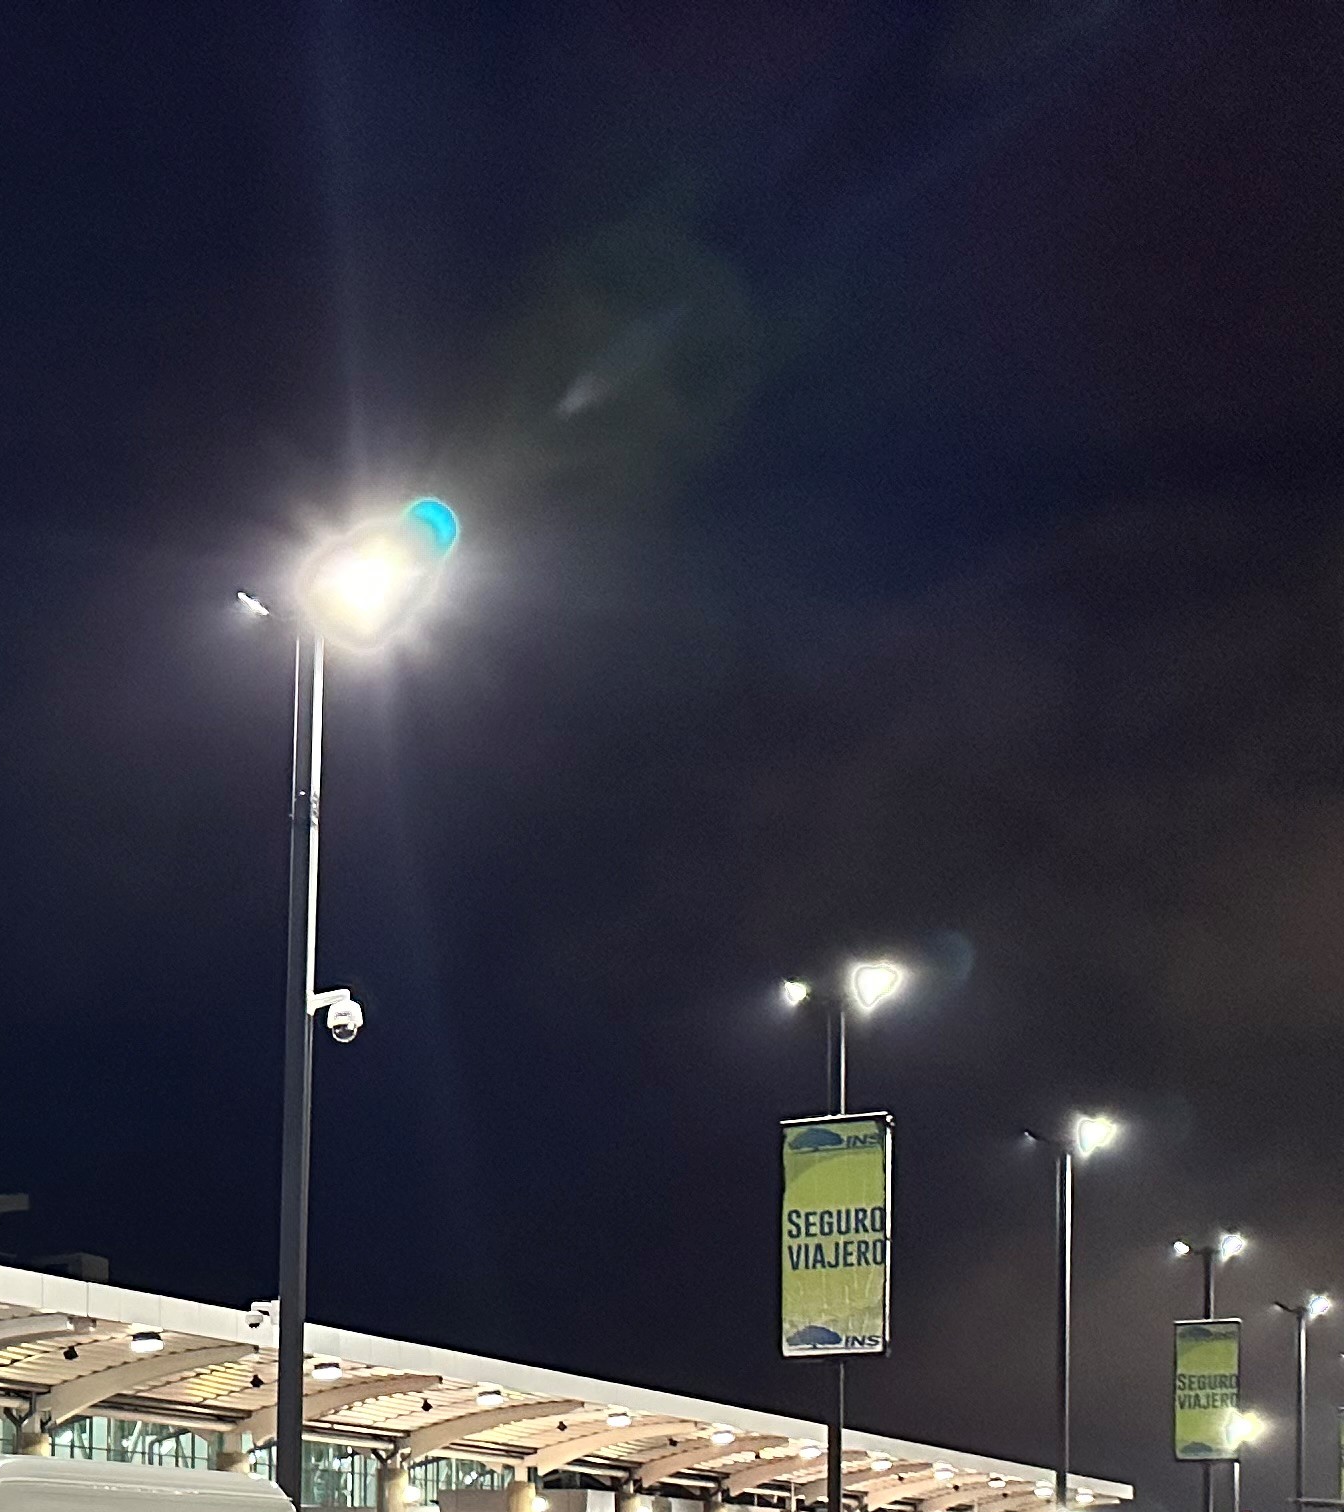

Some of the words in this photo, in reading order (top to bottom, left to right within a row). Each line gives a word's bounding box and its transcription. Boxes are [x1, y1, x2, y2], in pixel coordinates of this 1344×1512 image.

[787, 1207, 885, 1239] SEGURO
[787, 1239, 886, 1270] VIAJERO
[845, 1335, 881, 1347] INS
[1178, 1374, 1238, 1391] SEGURO
[1178, 1393, 1238, 1410] VIAJERO
